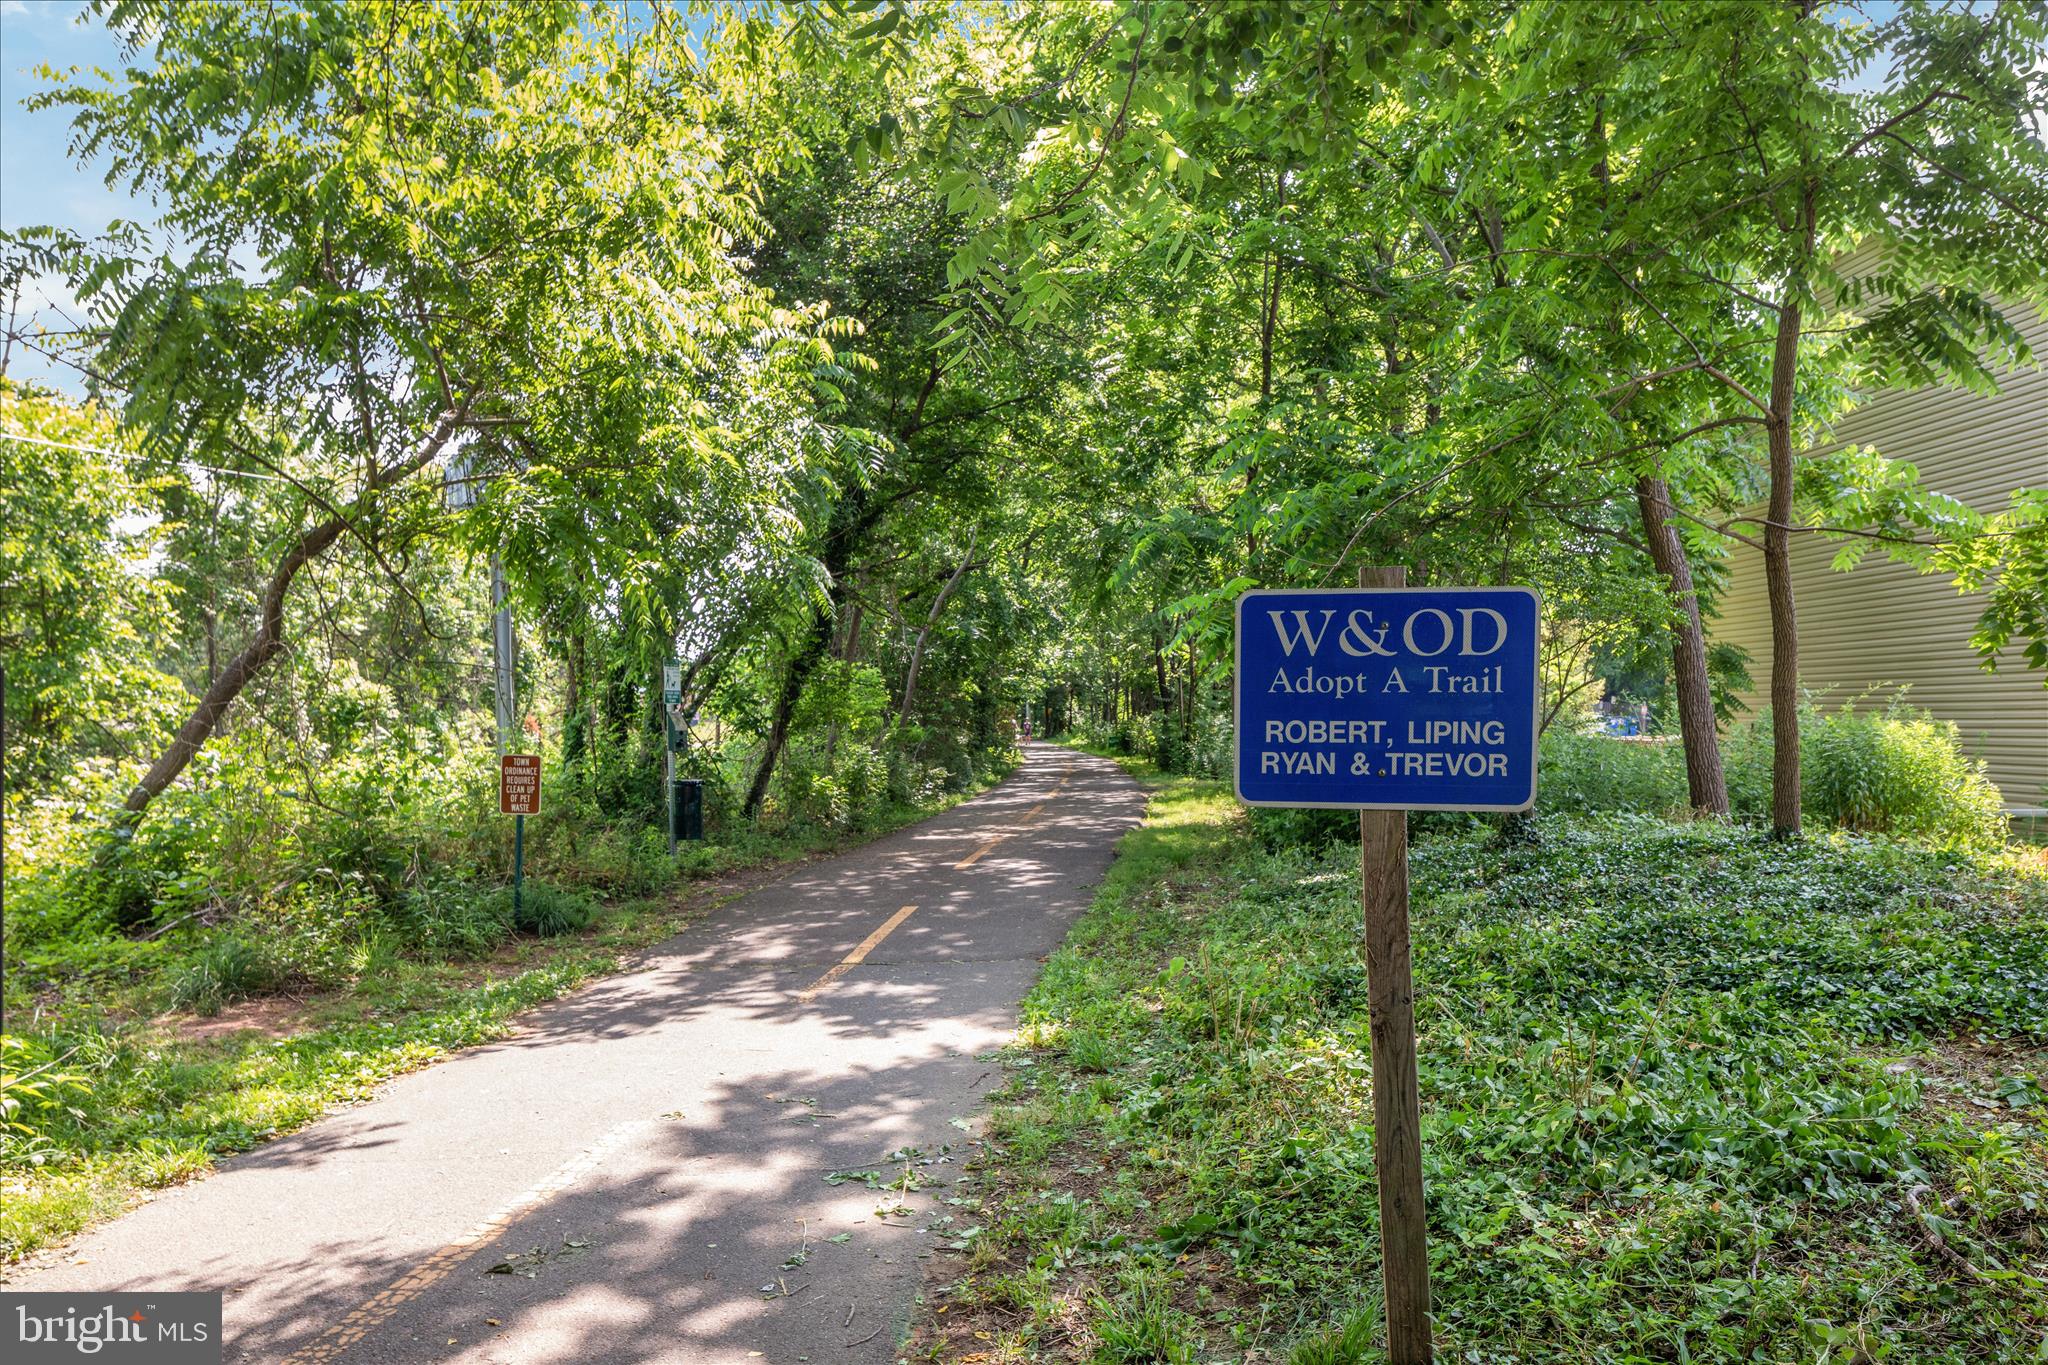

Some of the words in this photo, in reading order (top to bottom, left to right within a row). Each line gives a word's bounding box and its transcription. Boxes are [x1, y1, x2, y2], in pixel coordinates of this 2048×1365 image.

[1266, 607, 1508, 657] W&OD
[1267, 666, 1367, 699] Adopt
[1381, 666, 1410, 693] A
[1422, 665, 1504, 694] Trail
[1265, 720, 1393, 749] ROBERT,
[1408, 720, 1505, 745] LIPING
[513, 758, 530, 766] TOWN
[1261, 752, 1336, 775] RYAN
[1350, 752, 1370, 776] &
[1384, 752, 1508, 777] TREVOR
[504, 767, 538, 776] ORDINANCE
[506, 776, 535, 784] REQUIRES
[506, 785, 524, 794] CLEAN
[526, 786, 535, 794] UP
[510, 794, 518, 802] OF
[520, 794, 530, 802] PET
[511, 804, 530, 812] WASTE
